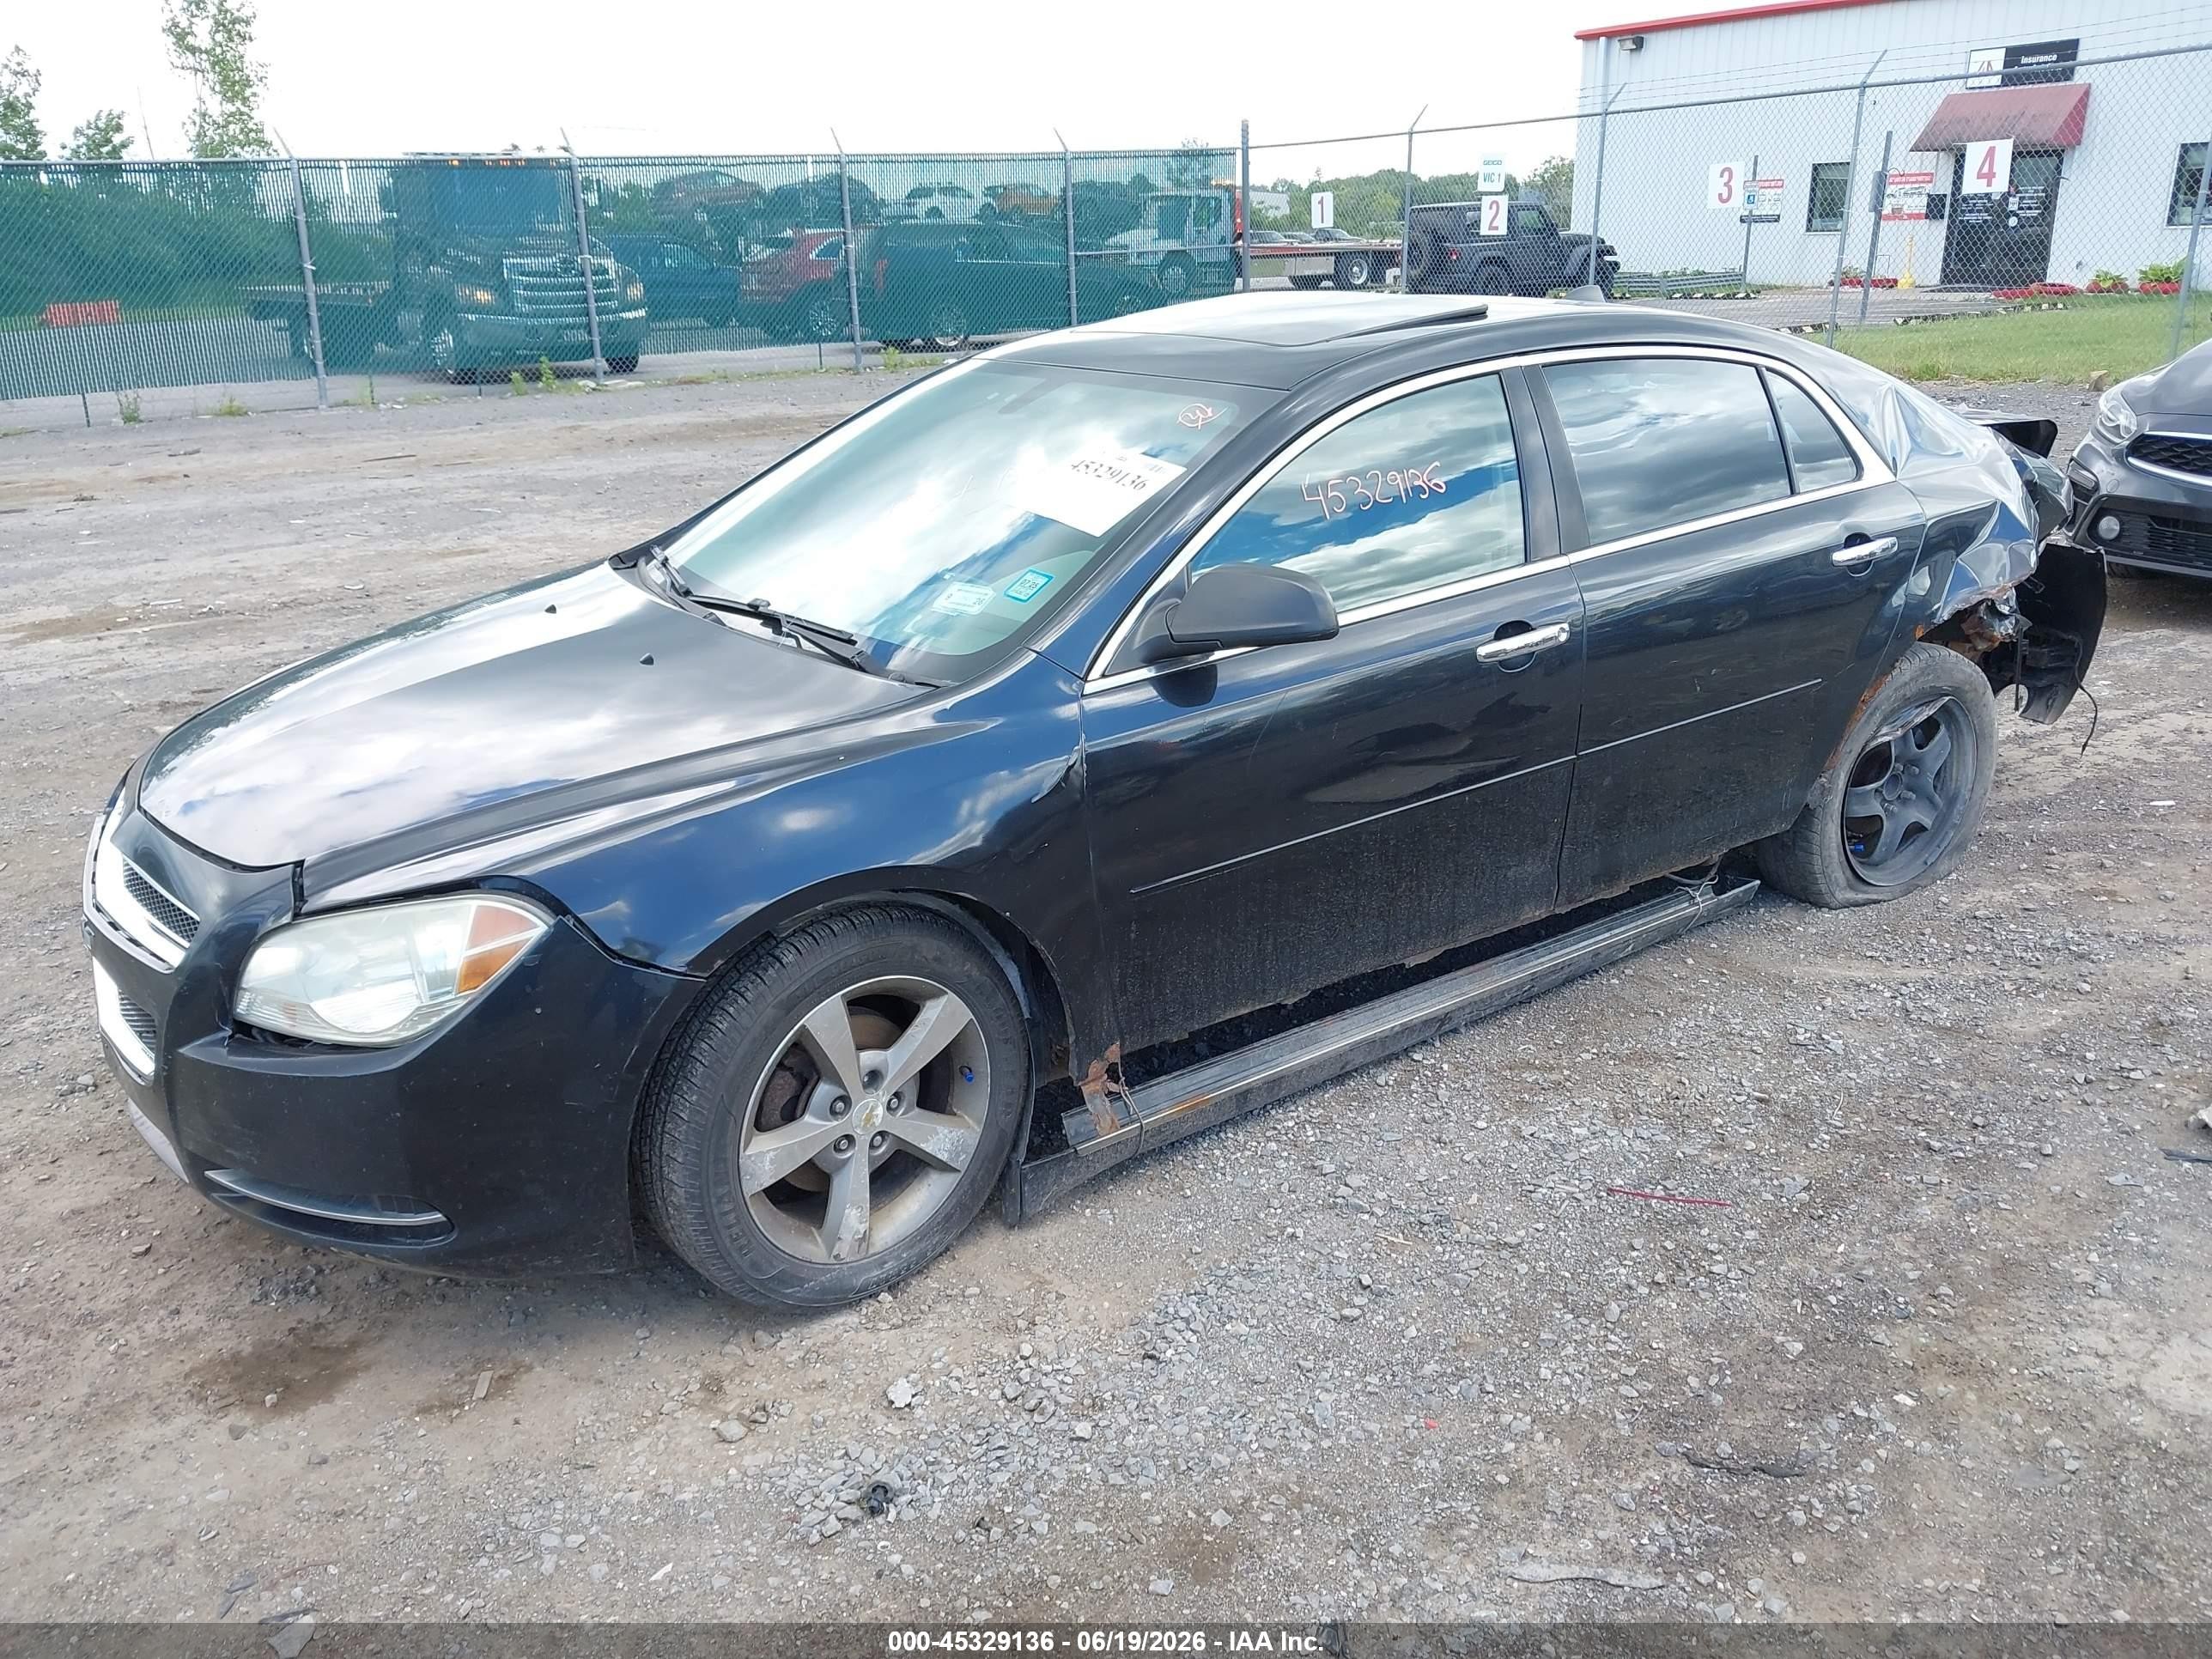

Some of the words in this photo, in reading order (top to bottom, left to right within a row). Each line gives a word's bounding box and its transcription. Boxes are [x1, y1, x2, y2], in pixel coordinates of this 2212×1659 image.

[2021, 53, 2057, 64] Insurance
[1483, 173, 1495, 183] VIC
[1498, 173, 1501, 183] 1
[1976, 145, 1996, 187] 4
[1717, 167, 1734, 204] 3
[1317, 196, 1324, 224] 1
[1487, 200, 1500, 231] 2
[1071, 459, 1150, 491] 45329136
[1300, 461, 1446, 520] 45329136
